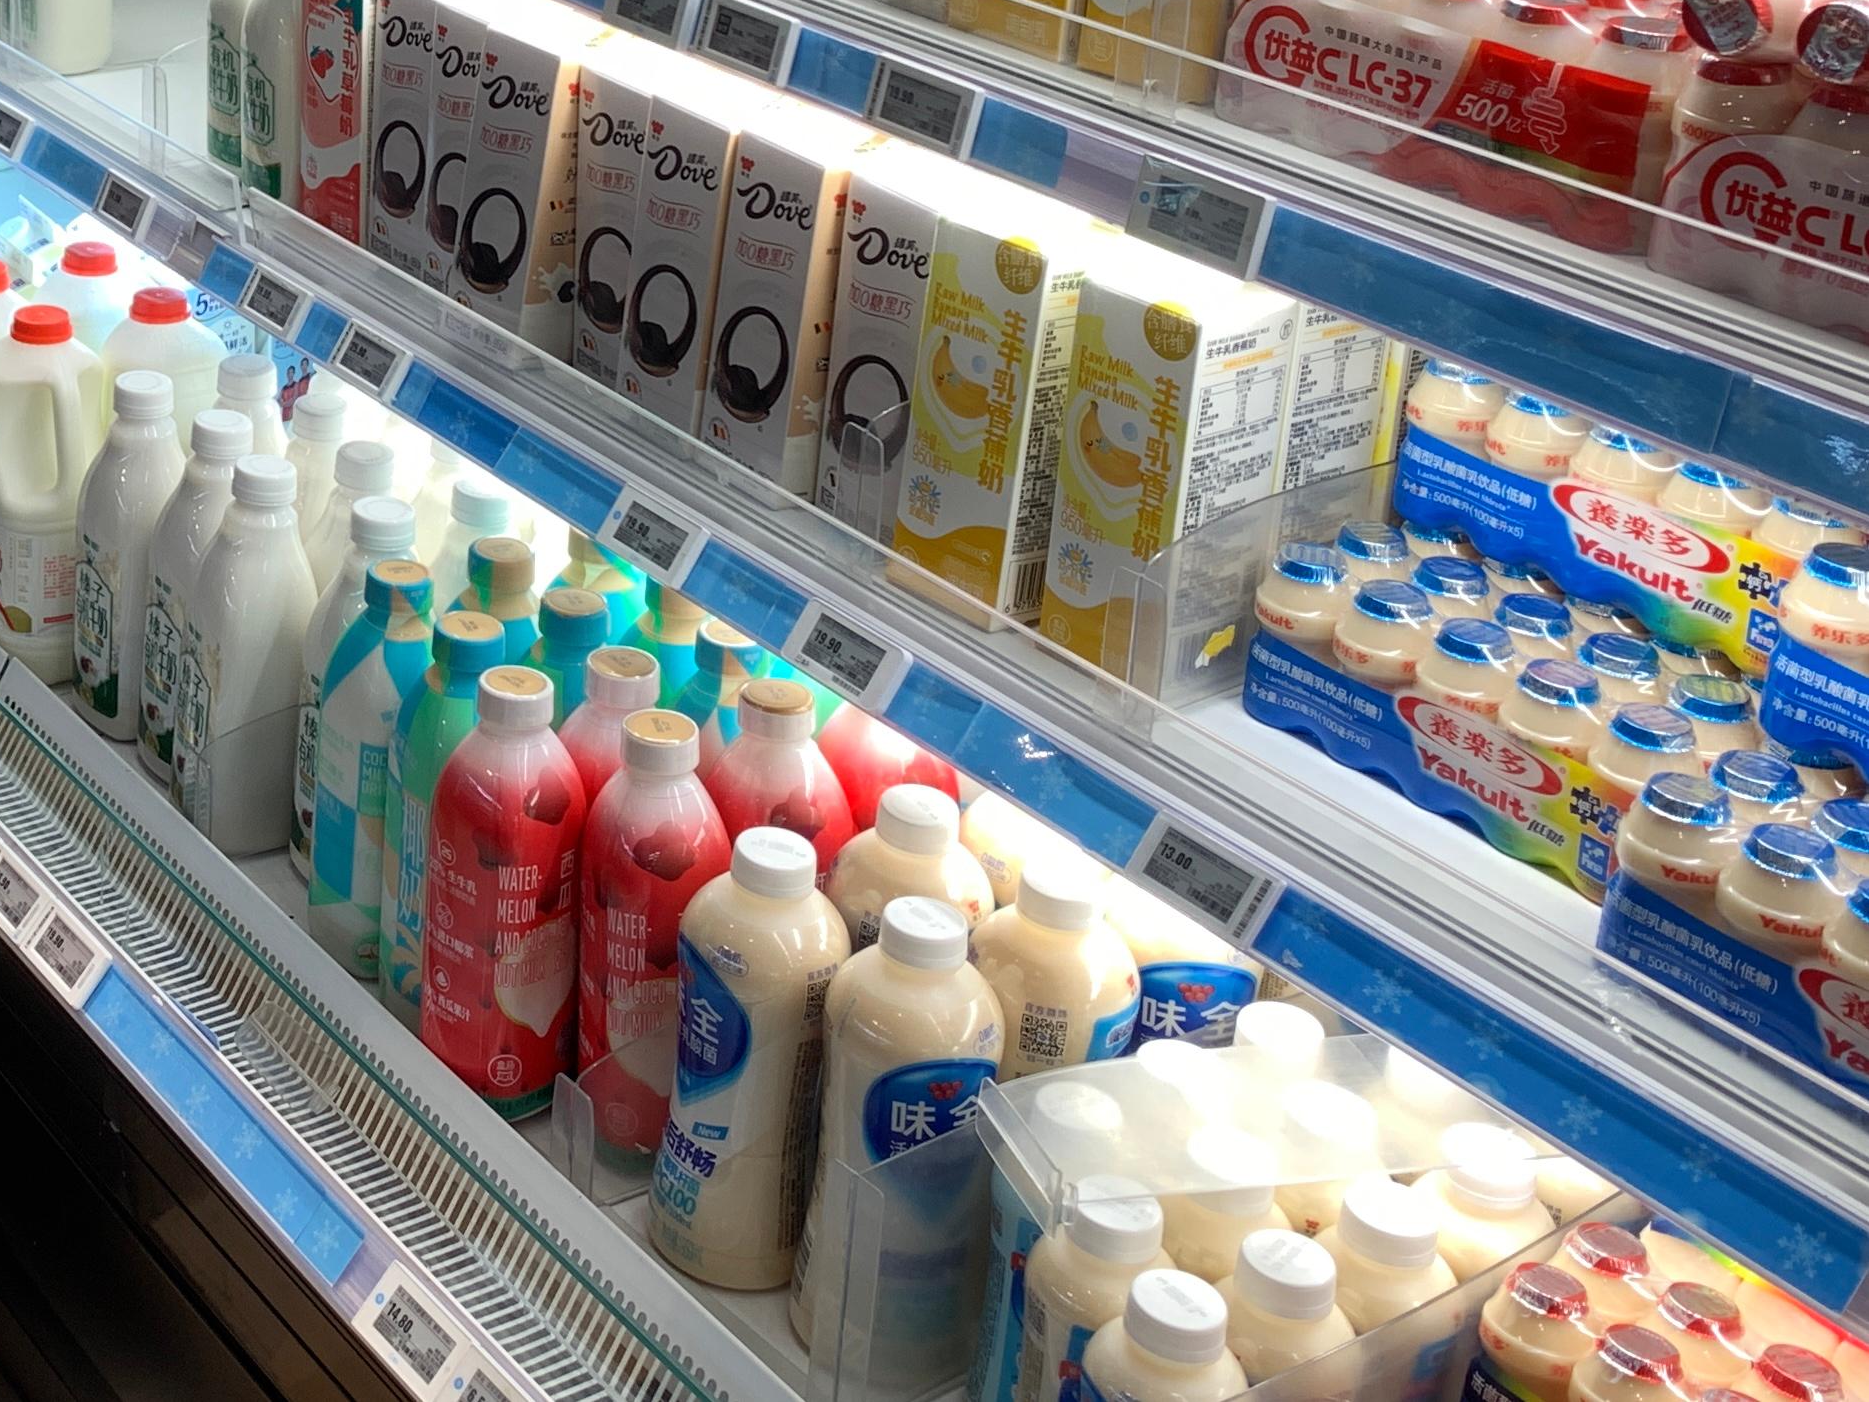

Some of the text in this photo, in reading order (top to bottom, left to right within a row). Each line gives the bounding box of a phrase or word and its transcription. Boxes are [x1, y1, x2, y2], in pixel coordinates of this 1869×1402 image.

[379, 16, 433, 52] Dove
[1324, 25, 1442, 71] 中国肠道大会指定产品
[211, 46, 235, 72] 有机
[340, 8, 357, 137] 生牛乳草莓奶
[436, 46, 480, 78] Dov
[1264, 29, 1433, 108] 优益C LC-37
[482, 75, 550, 116] Dove
[1481, 78, 1516, 100] 活菌
[1456, 94, 1522, 134] 500亿
[582, 112, 646, 154] Dove
[648, 145, 718, 191] Dove
[737, 182, 813, 230] Dove
[1725, 180, 1831, 248] 优益C
[847, 227, 930, 279] Dove
[962, 290, 985, 312] Milk
[1108, 355, 1133, 378] Milk
[978, 309, 1027, 494] 生牛乳香蕉奶
[1132, 375, 1180, 562] 生牛乳香蕉奶
[627, 515, 651, 538] 19.90
[1574, 532, 1694, 603] Yakult
[1257, 604, 1295, 630] Yakult
[814, 628, 842, 654] 19.90
[1417, 745, 1530, 823] Yakult
[1160, 842, 1193, 870] 13.00
[498, 865, 543, 891] WATER-
[496, 898, 536, 924] MELON
[607, 908, 652, 939] WATER-
[495, 931, 520, 955] AND
[607, 944, 646, 972] MELON
[495, 962, 518, 989] NUT
[606, 977, 629, 1000] AND
[697, 1126, 722, 1138] New
[387, 1302, 413, 1334] 14.80
